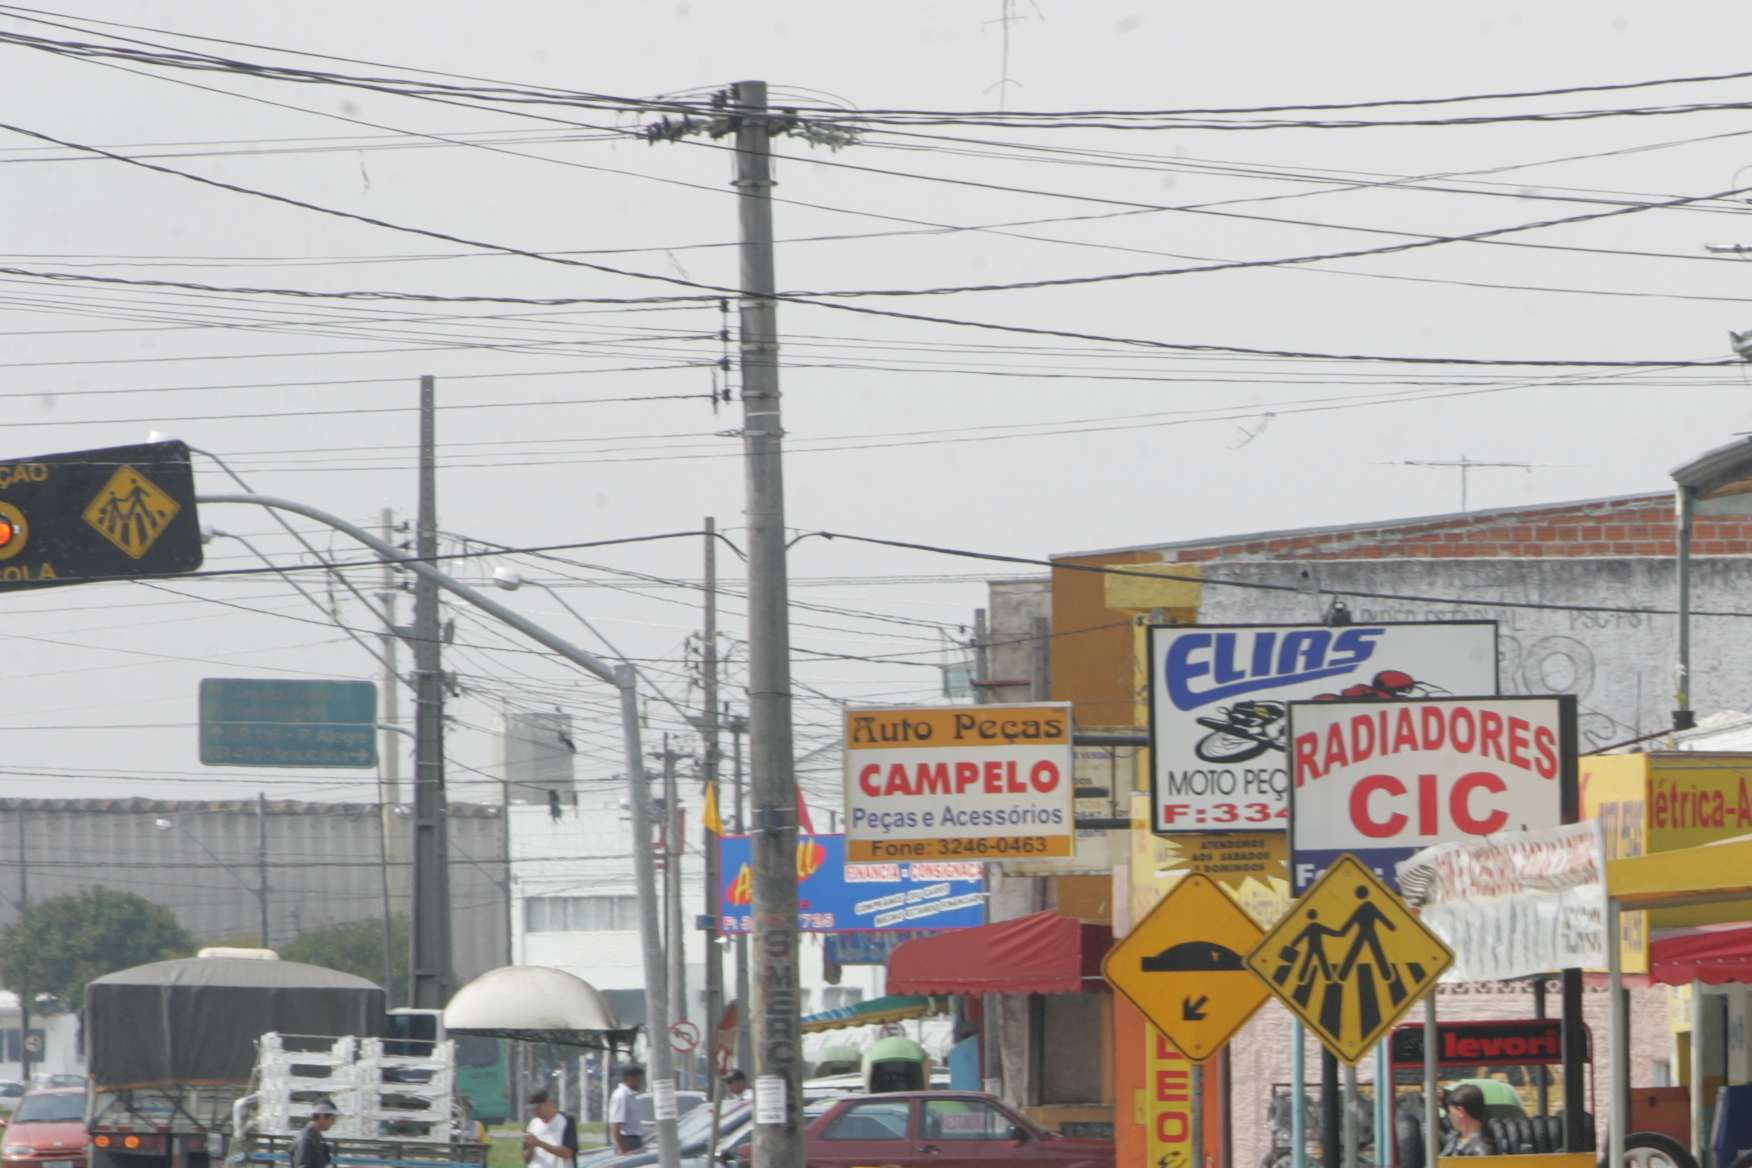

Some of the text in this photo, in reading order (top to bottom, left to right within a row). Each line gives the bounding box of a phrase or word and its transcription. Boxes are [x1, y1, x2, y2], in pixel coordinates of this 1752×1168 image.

[1165, 628, 1387, 711] ELIAS
[852, 713, 1064, 745] Auto Peças
[1294, 705, 1559, 790] RADIADORES
[858, 759, 1061, 798] CAMPELO
[1167, 768, 1288, 801] MOTO PEÇ
[851, 803, 1064, 834] Peças e Acessórios
[1348, 770, 1511, 840] CIC
[870, 835, 1049, 858] Fone: 3246-0463
[1443, 1029, 1561, 1058] levori
